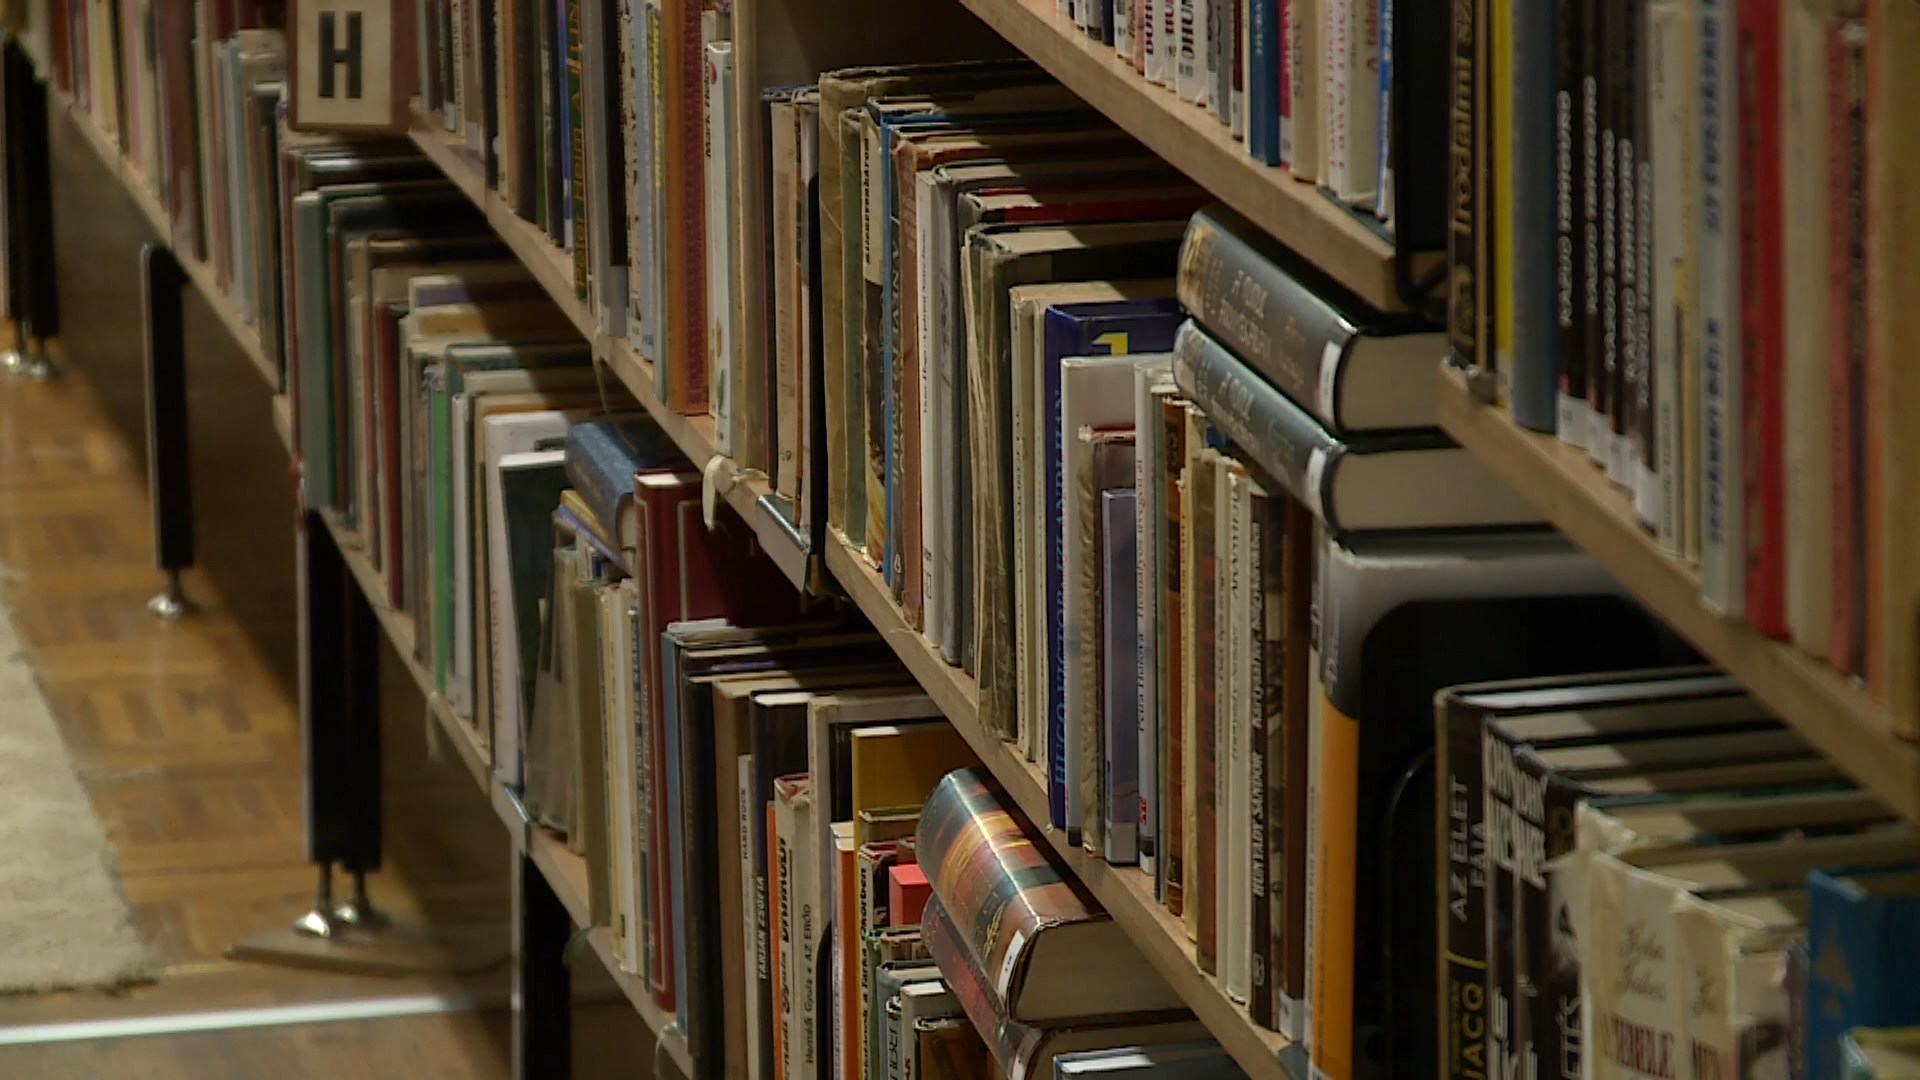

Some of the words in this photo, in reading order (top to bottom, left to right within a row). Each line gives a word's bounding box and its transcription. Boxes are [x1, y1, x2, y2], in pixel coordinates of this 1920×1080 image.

[318, 11, 362, 99] H
[1555, 89, 1572, 233] ISHIGURO
[1583, 75, 1598, 221] ISHIGURO
[1602, 127, 1616, 275] ISHIGURO
[1618, 136, 1636, 287] ISHIGURO
[1556, 235, 1573, 327] KAZUO
[1584, 221, 1598, 315] KAZUO
[1602, 276, 1616, 372] KAZUO
[1621, 287, 1637, 384] KAZUO
[1055, 721, 1066, 785] HUGO
[1449, 872, 1468, 922] AZ
[804, 944, 812, 961] AZ
[804, 979, 814, 1012] Gyula
[804, 1017, 813, 1064] Hernádi
